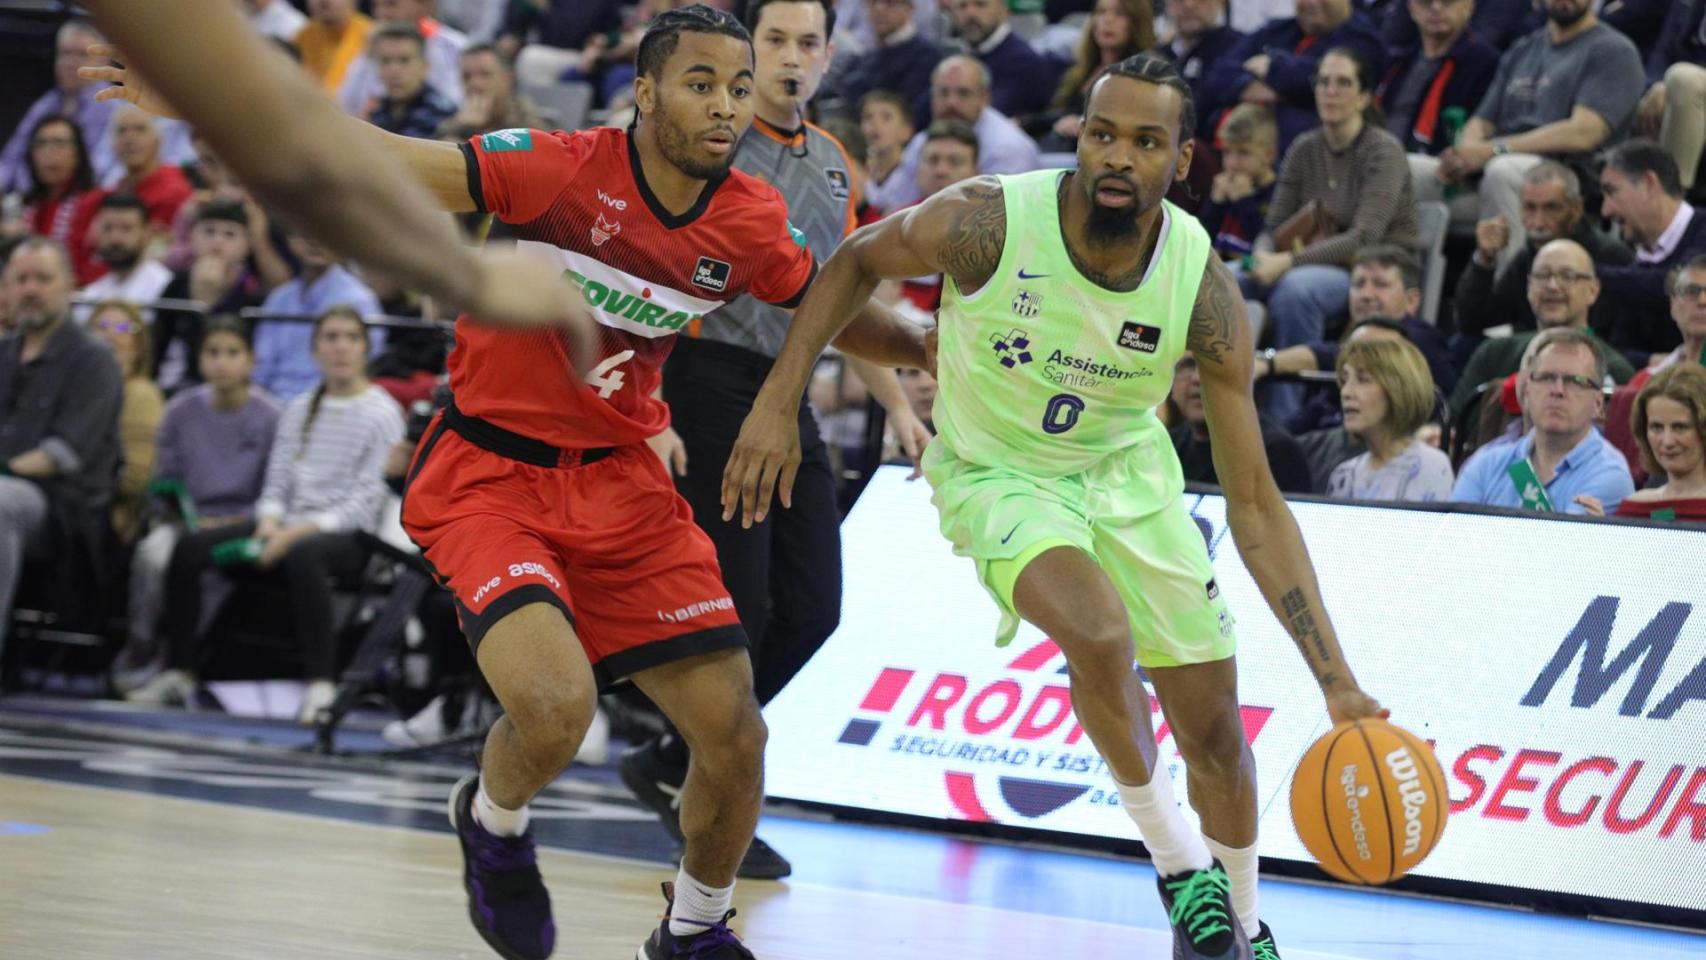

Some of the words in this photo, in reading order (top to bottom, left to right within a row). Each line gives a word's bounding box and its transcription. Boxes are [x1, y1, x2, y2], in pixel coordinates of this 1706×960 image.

[597, 188, 627, 210] vive
[1120, 337, 1155, 351] endesa
[1123, 329, 1140, 340] liga
[1042, 393, 1085, 434] 0
[473, 576, 501, 603] vive
[1036, 754, 1051, 768] Y
[1385, 746, 1427, 857] Wilson
[1424, 739, 1706, 843] SEGUR
[1346, 797, 1372, 860] endesa
